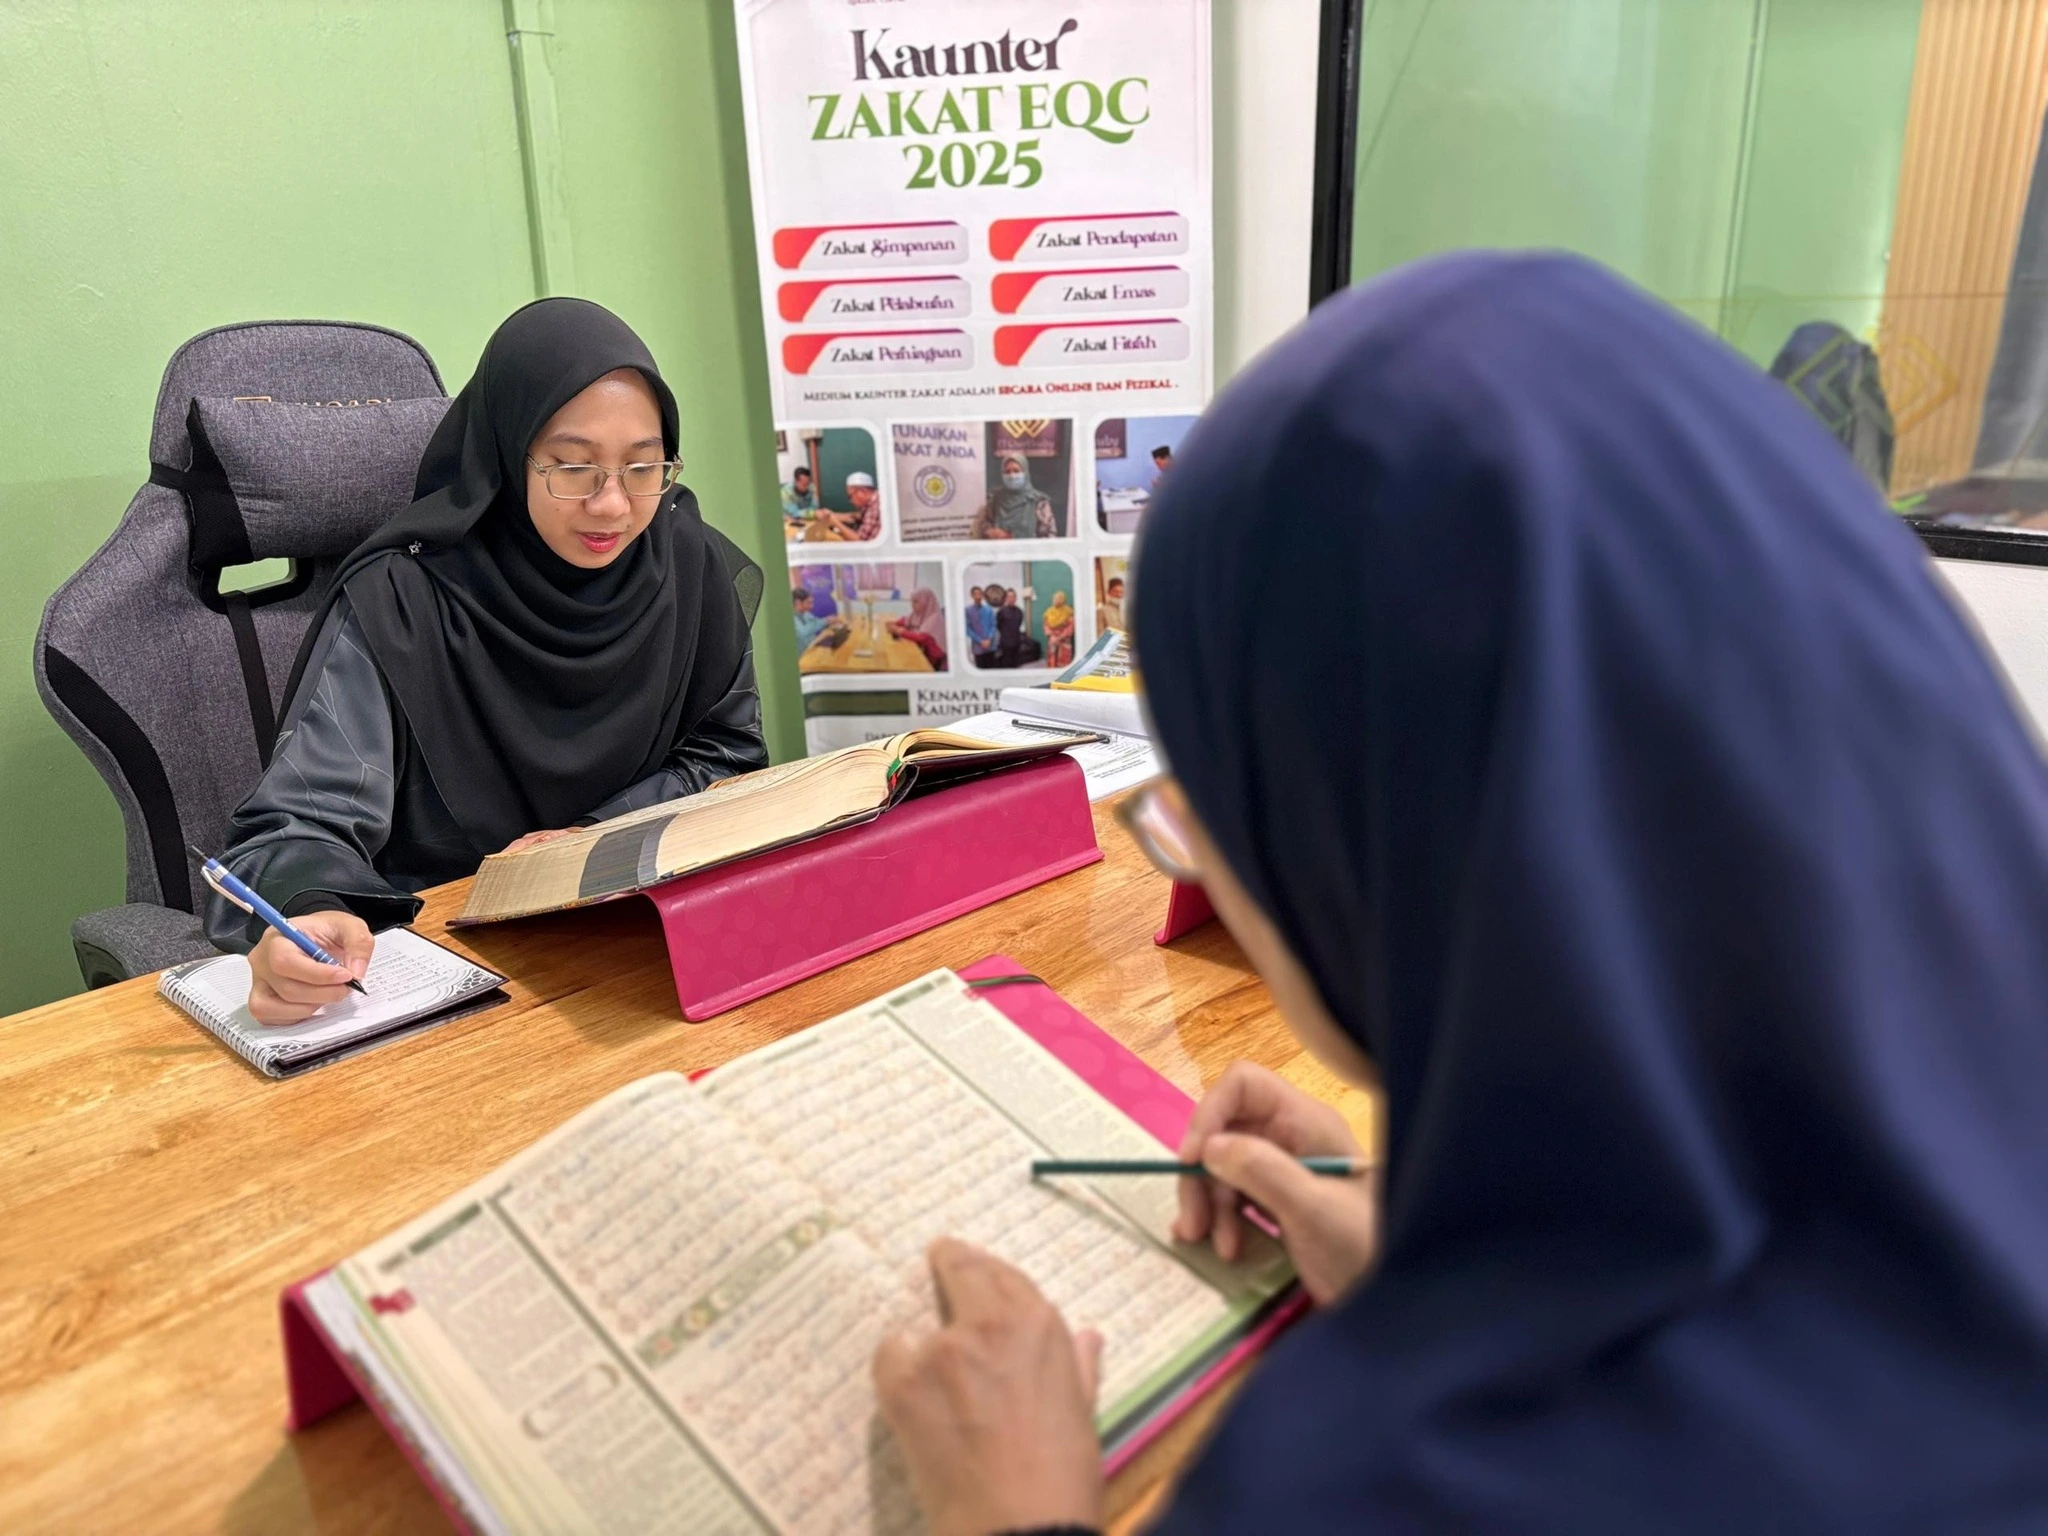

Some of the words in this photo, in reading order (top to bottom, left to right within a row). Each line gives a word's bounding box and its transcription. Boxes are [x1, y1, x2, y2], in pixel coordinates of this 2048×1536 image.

[849, 18, 1078, 82] Kaunter
[808, 86, 1003, 141] ZAKAT
[1018, 77, 1150, 144] EQC
[902, 138, 1043, 190] 2025
[822, 240, 866, 256] Zakat
[871, 238, 956, 257] Simpanan
[1036, 232, 1082, 248] Zakat
[1086, 229, 1178, 249] Pendapatan
[1063, 286, 1107, 302] Zakat
[1112, 284, 1156, 300] Emas
[831, 298, 875, 314] Zakat
[1063, 337, 1107, 352] Zakat
[1112, 335, 1157, 351] Fitrah
[831, 347, 874, 363] Zakat
[854, 389, 905, 400] KAUNTER
[911, 388, 946, 398] ZAKAT
[949, 386, 996, 397] ADALAH
[998, 385, 1042, 396] SECARA
[1096, 381, 1122, 392] DAN
[937, 445, 976, 460] ANDA
[917, 688, 979, 702] KENAPA
[917, 702, 991, 717] KAUNTER
